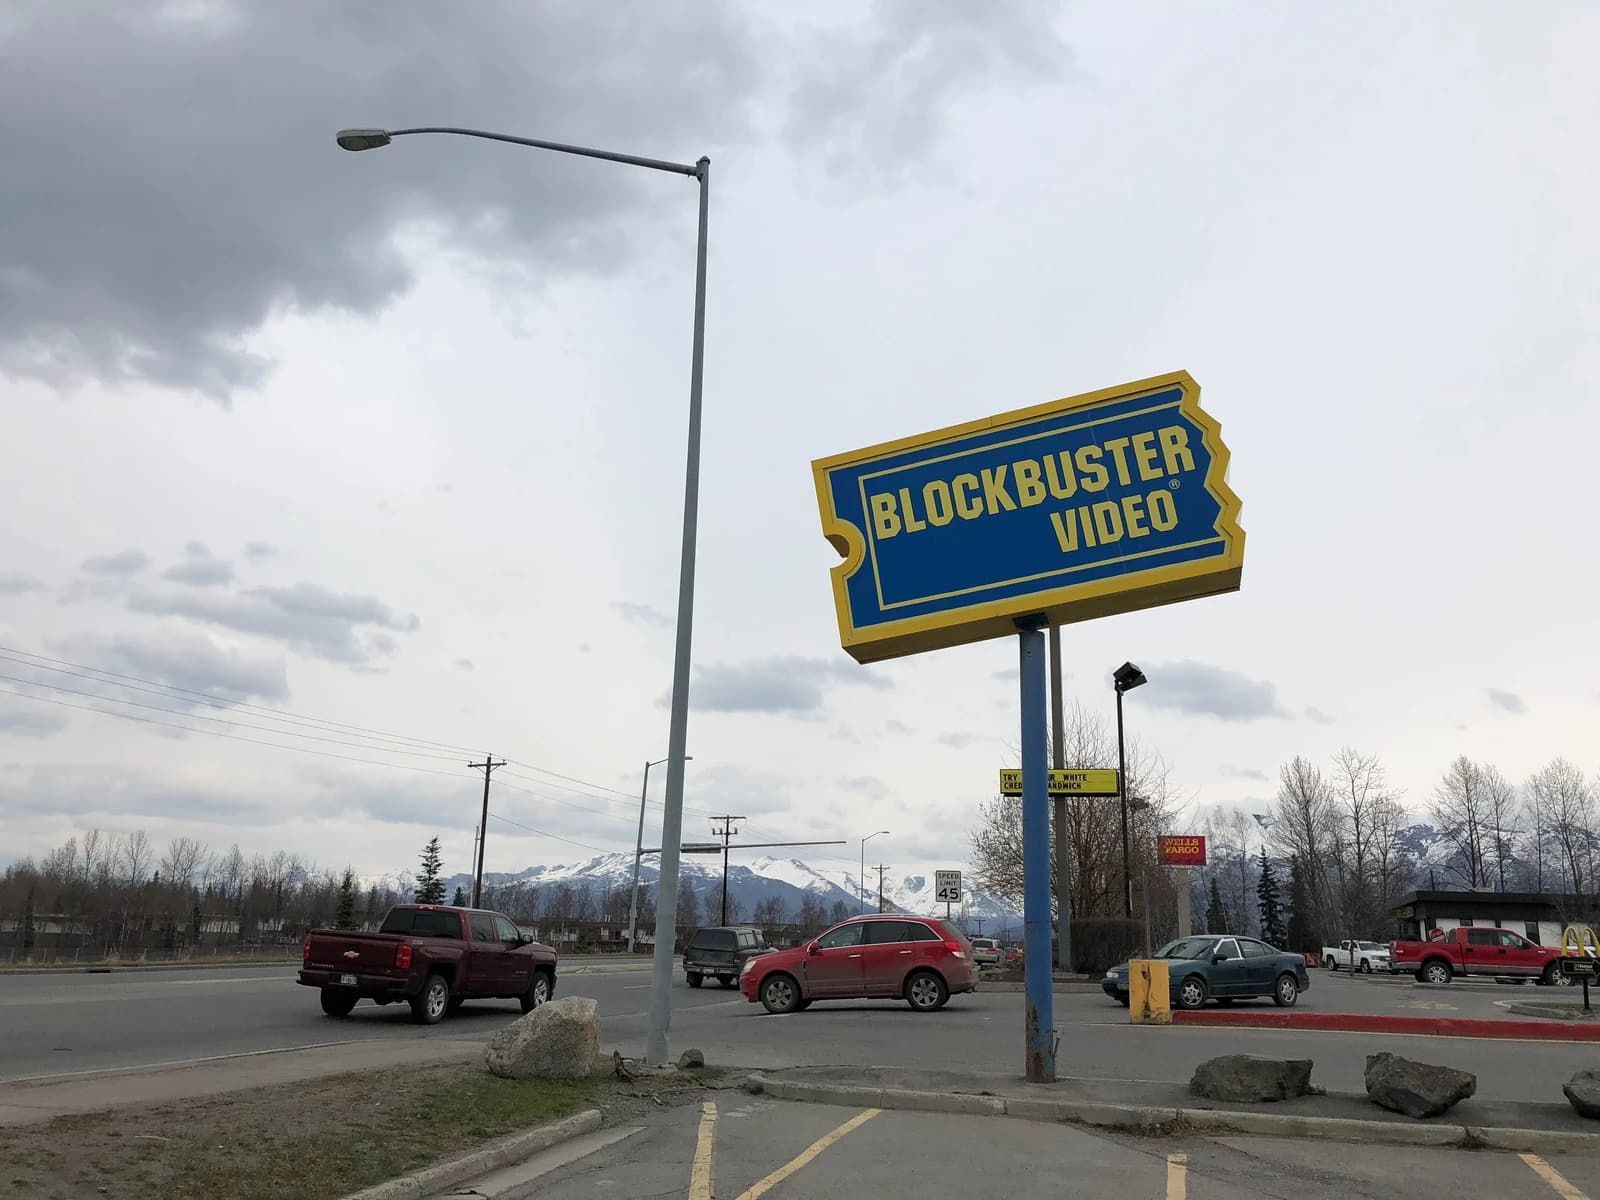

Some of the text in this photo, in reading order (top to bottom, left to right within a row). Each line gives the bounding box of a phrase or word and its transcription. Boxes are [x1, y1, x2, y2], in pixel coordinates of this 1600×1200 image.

[870, 425, 1196, 540] BLOCKBUSTER
[1049, 489, 1179, 553] VIDEO
[1165, 838, 1199, 846] WELLS
[1165, 846, 1200, 854] FARGO
[938, 887, 959, 900] 45
